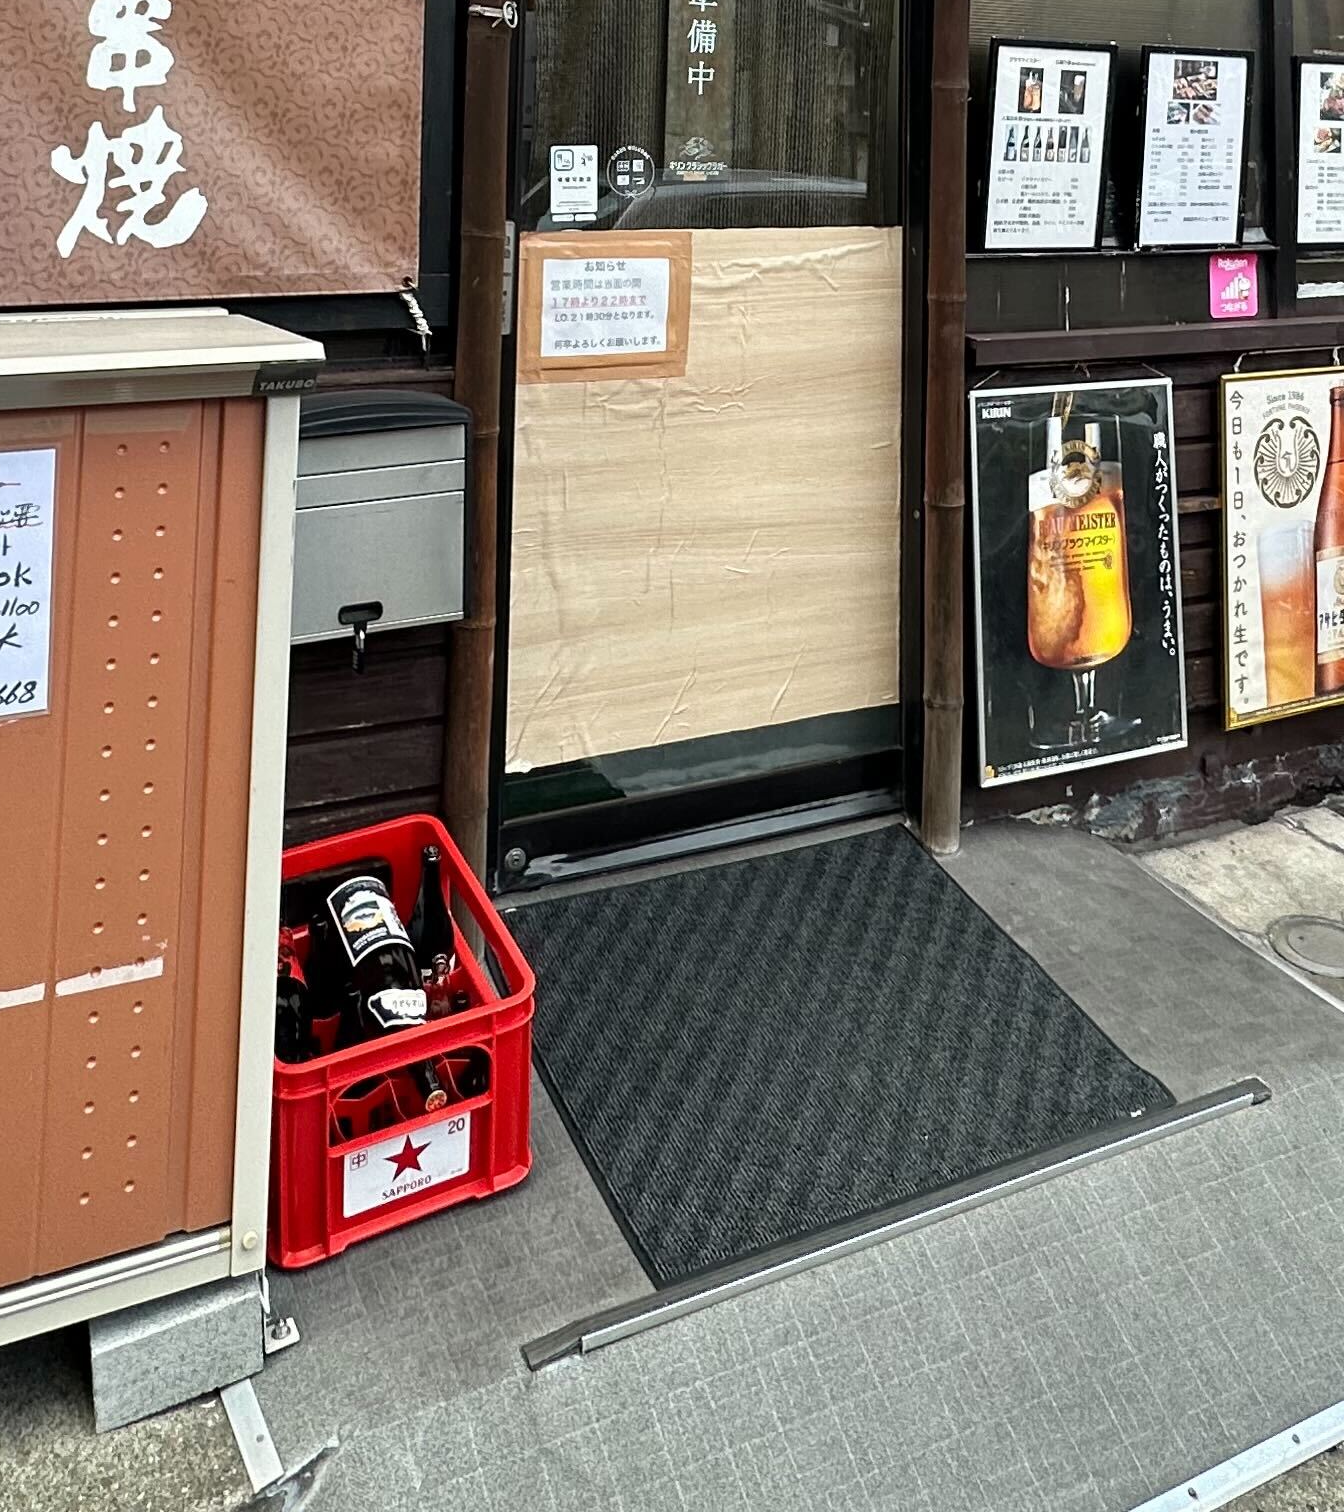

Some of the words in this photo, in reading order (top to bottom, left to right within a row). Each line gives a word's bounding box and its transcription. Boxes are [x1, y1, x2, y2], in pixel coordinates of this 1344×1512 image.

[584, 261, 626, 272] お知らせ
[259, 379, 315, 391] TAKUBO
[981, 407, 1012, 419] KIRIN
[448, 1118, 465, 1134] 20
[381, 1175, 432, 1200] SAPPORO
